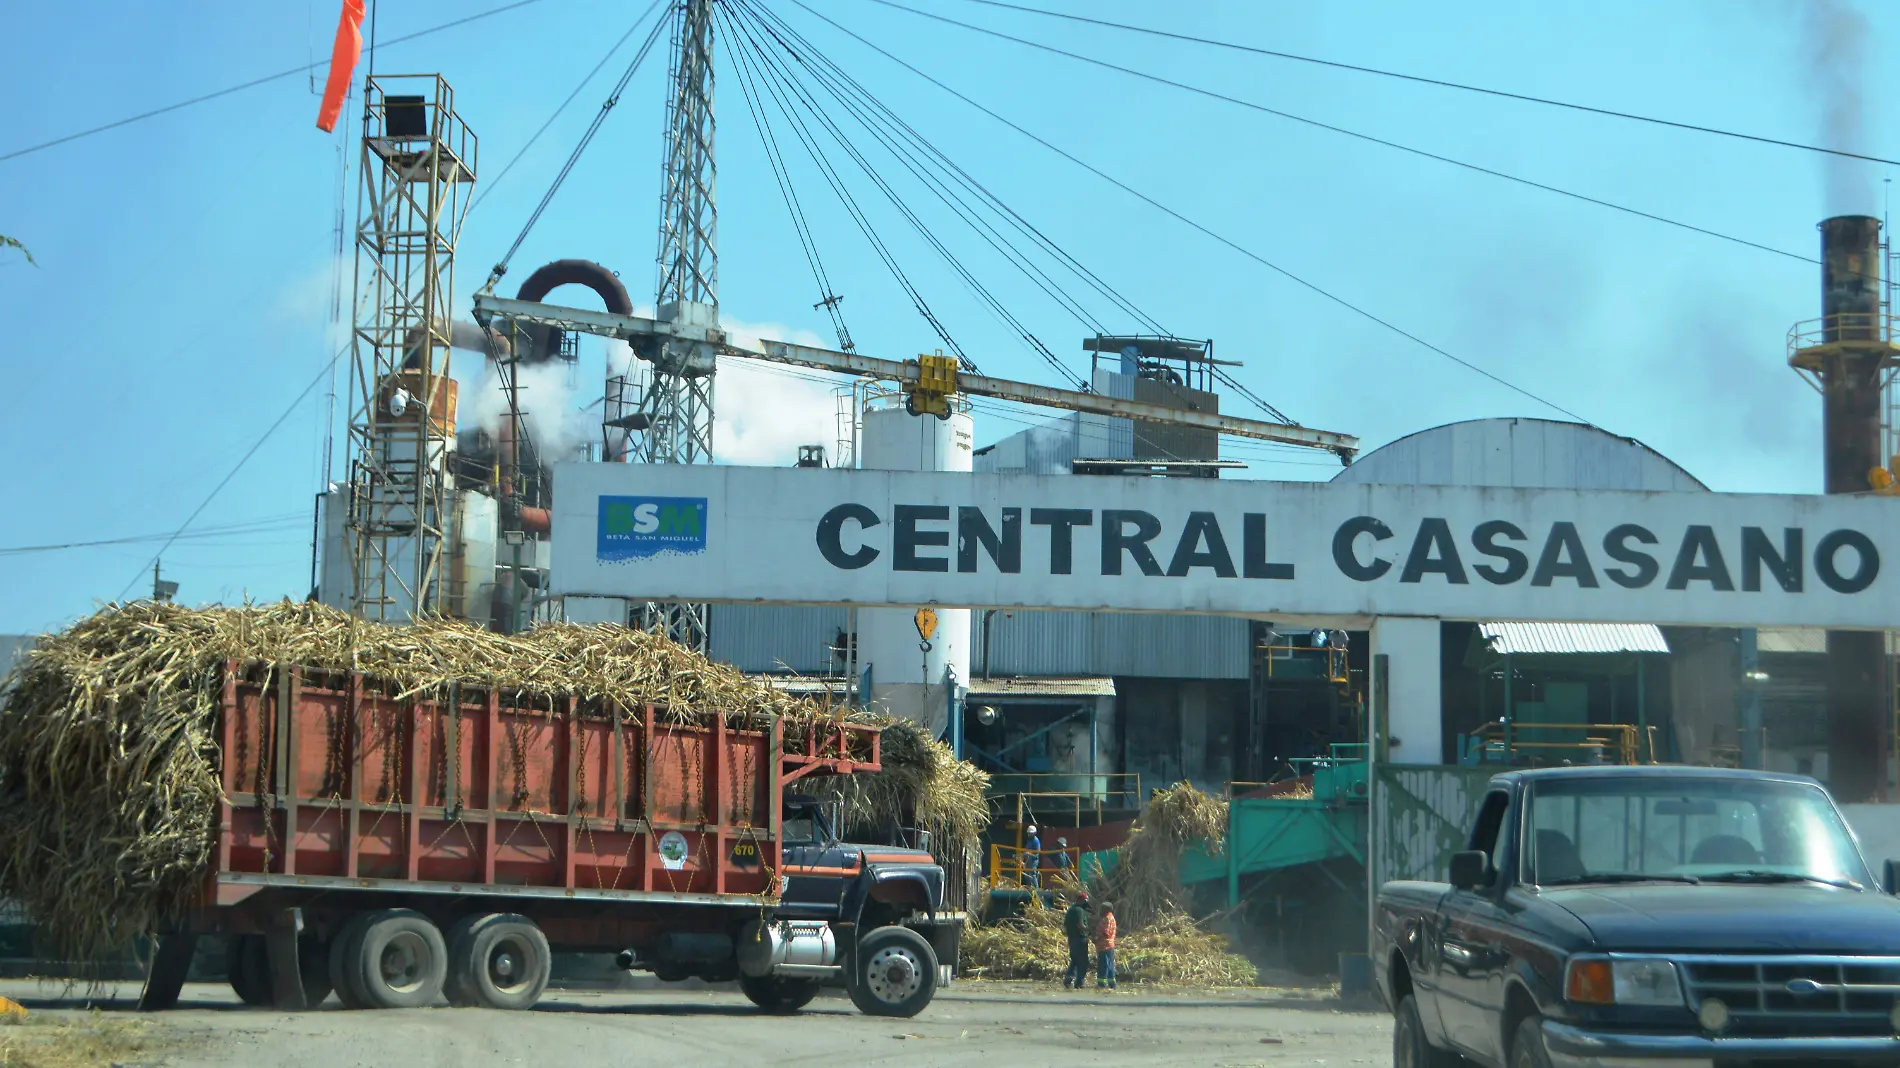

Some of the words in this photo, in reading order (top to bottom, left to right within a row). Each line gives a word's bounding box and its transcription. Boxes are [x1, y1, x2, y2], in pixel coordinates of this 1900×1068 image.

[606, 503, 702, 535] BSM
[815, 503, 1295, 580] CENTRAL
[1332, 516, 1880, 595] CASASANO
[734, 844, 755, 856] 670
